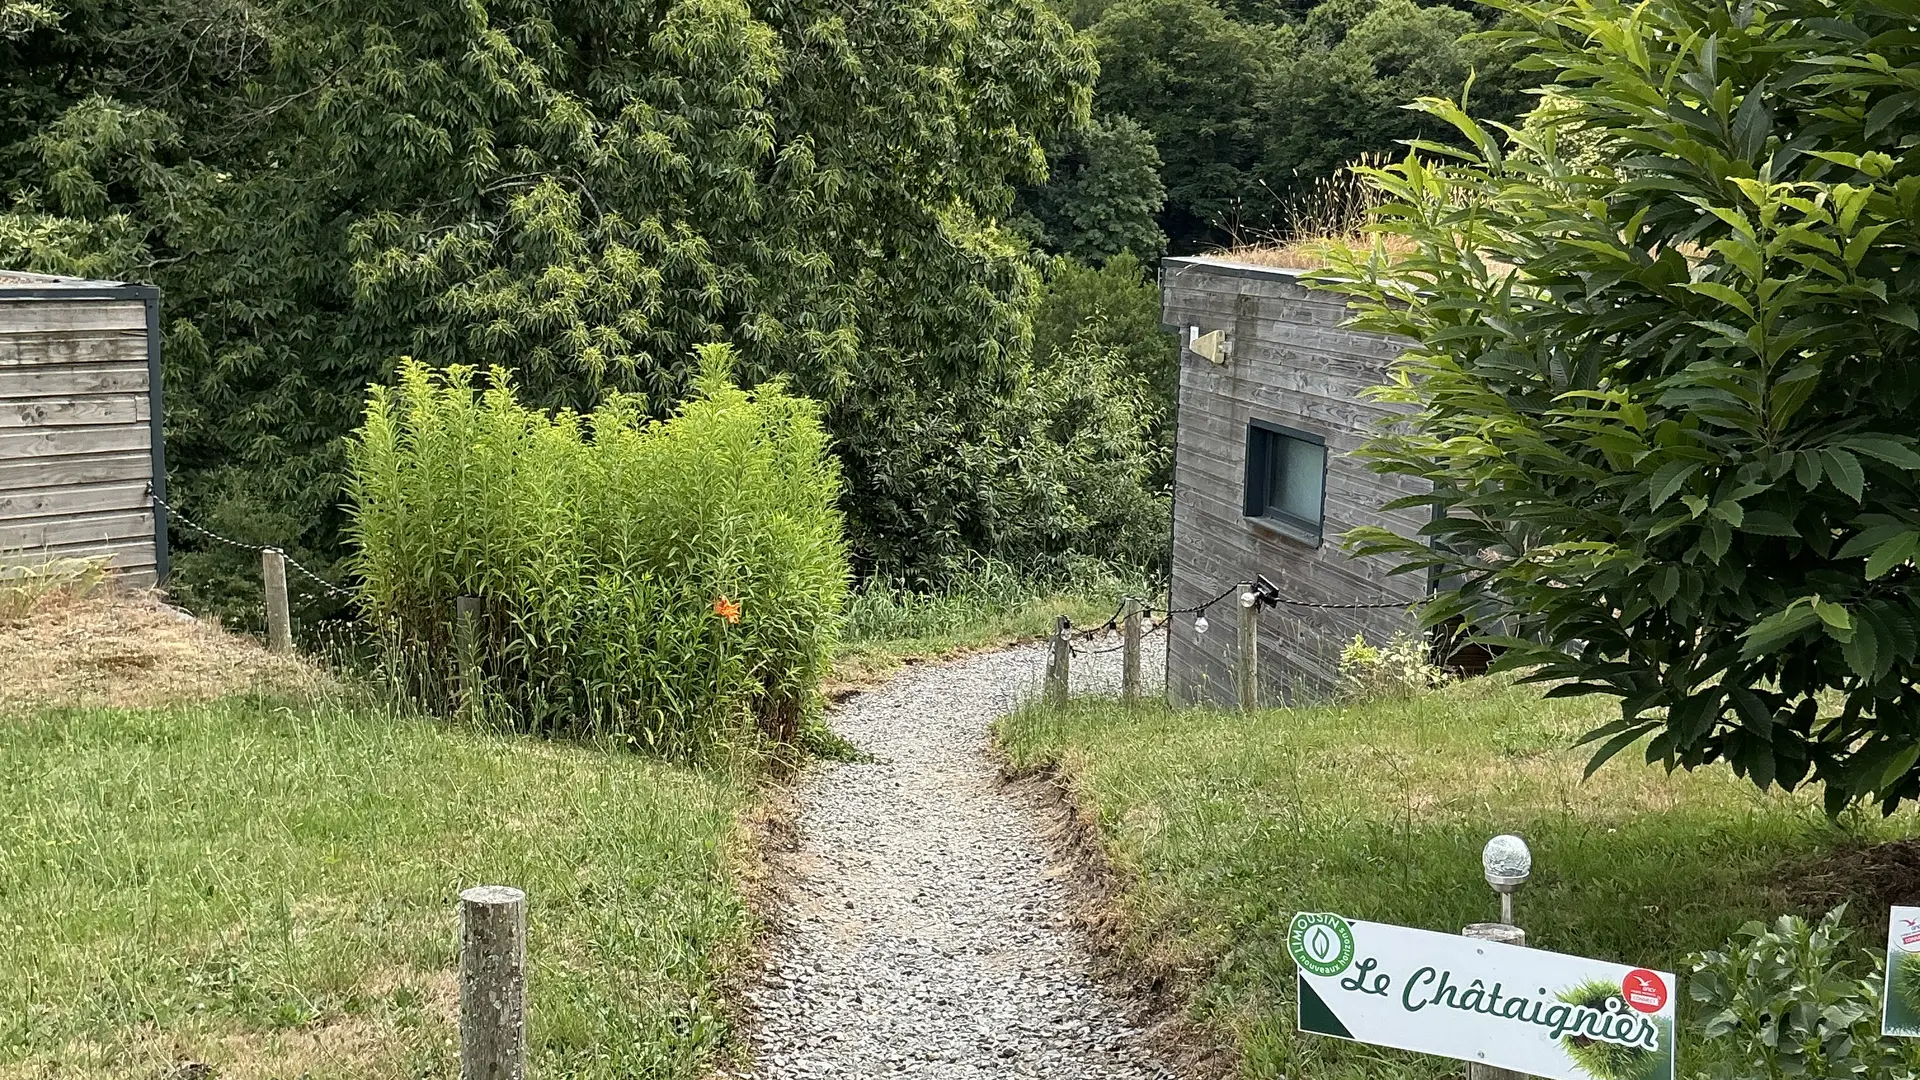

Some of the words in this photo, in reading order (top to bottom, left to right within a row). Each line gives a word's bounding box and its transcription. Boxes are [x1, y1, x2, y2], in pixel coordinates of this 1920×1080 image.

[1292, 914, 1339, 953] LIMOUSIN
[1299, 955, 1340, 974] nouveaux
[1338, 927, 1351, 967] horizons
[1341, 957, 1391, 997] Le
[1402, 967, 1657, 1048] Châtaignier
